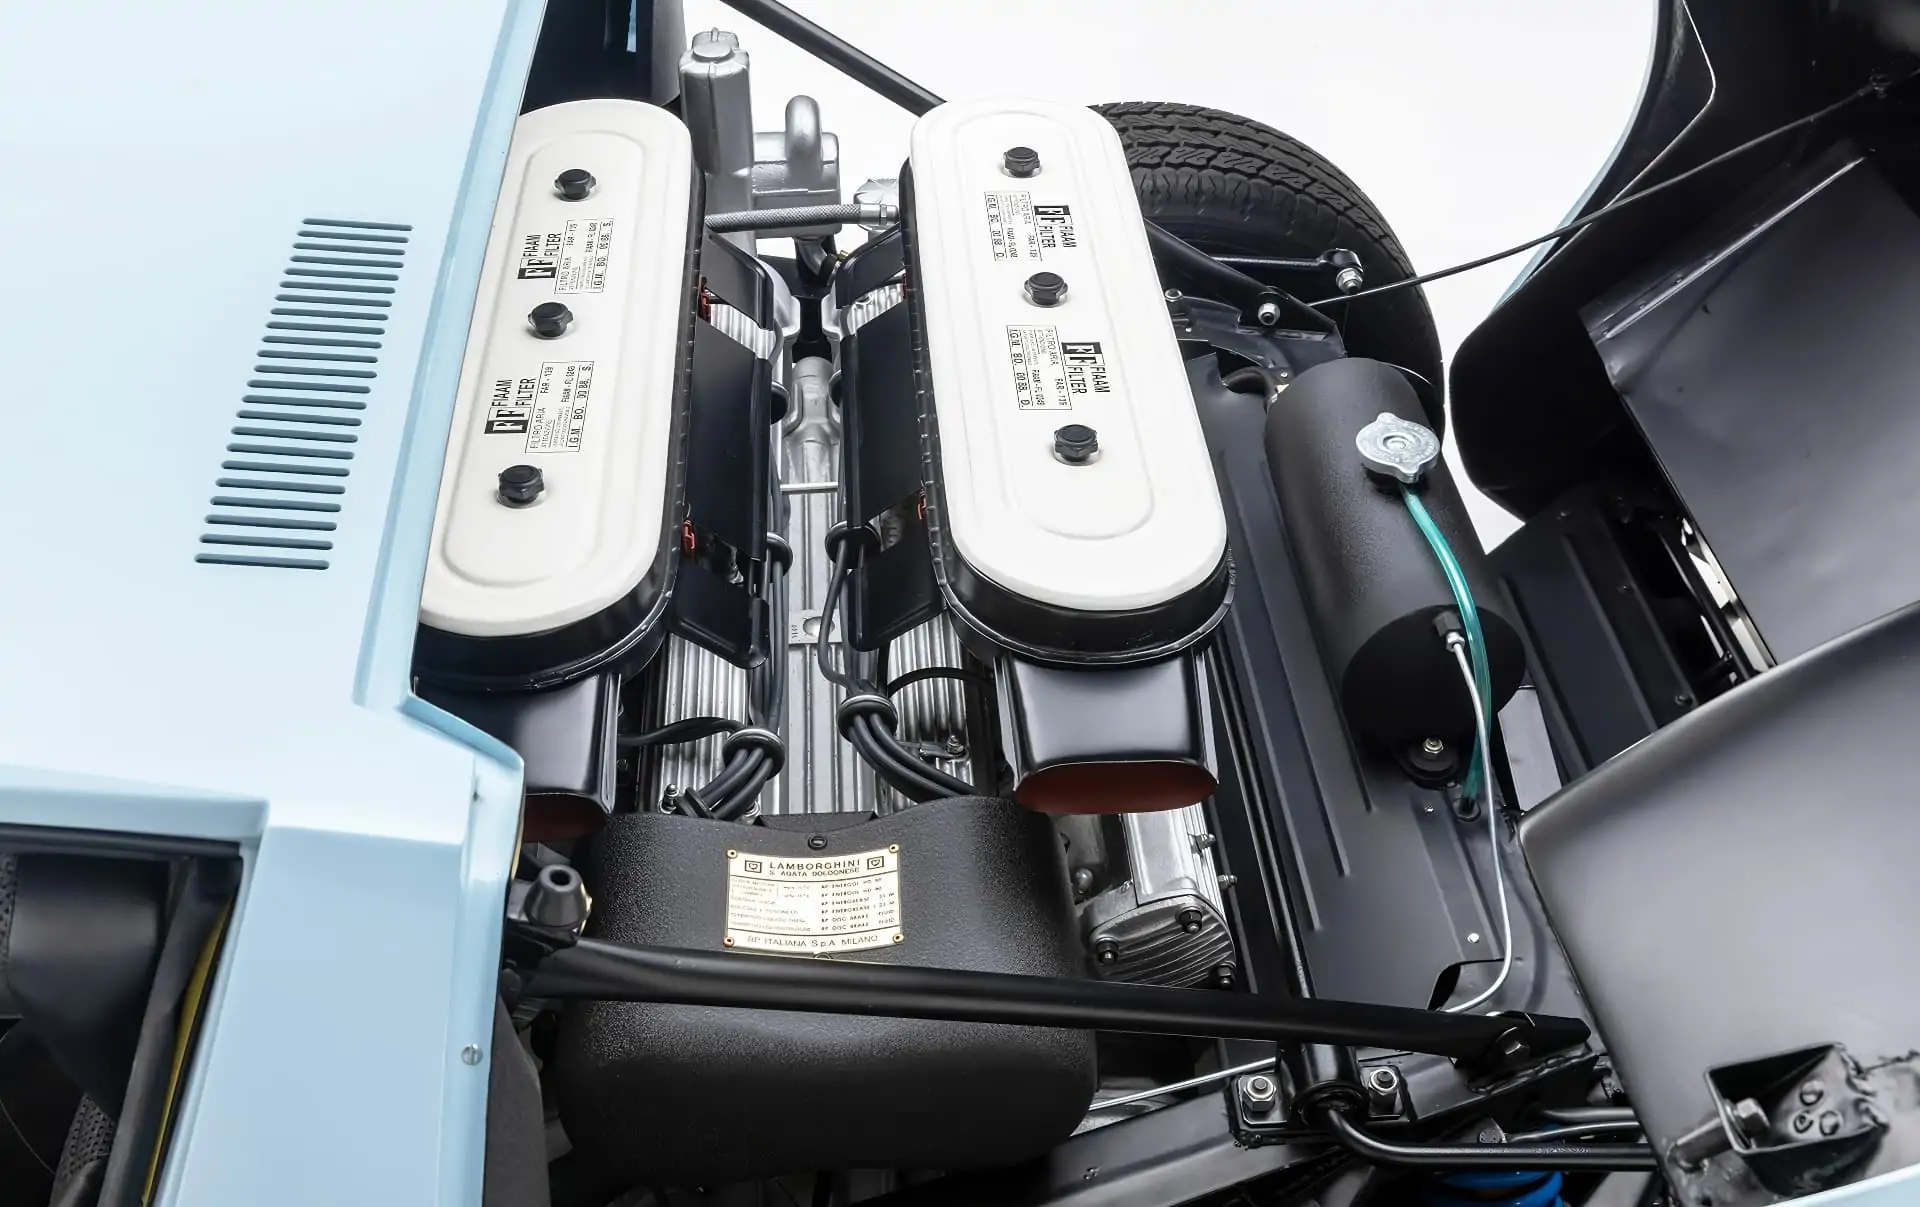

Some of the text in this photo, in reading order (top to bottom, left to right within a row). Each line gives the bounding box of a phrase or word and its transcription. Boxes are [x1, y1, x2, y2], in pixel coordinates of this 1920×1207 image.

[523, 234, 541, 257] FIAAM
[544, 232, 562, 257] FILTER
[1039, 225, 1056, 249] FILTER
[1059, 225, 1078, 248] FIAAM
[515, 378, 536, 406] FILTER
[1067, 366, 1088, 394] FILTER
[1090, 366, 1111, 393] FIAAM
[491, 379, 513, 407] FIAAM
[529, 407, 545, 448] FILTRO ARIA
[769, 859, 860, 871] LAMBORGHINI
[764, 938, 807, 947] ITALIANA
[841, 935, 878, 945] MILANO
